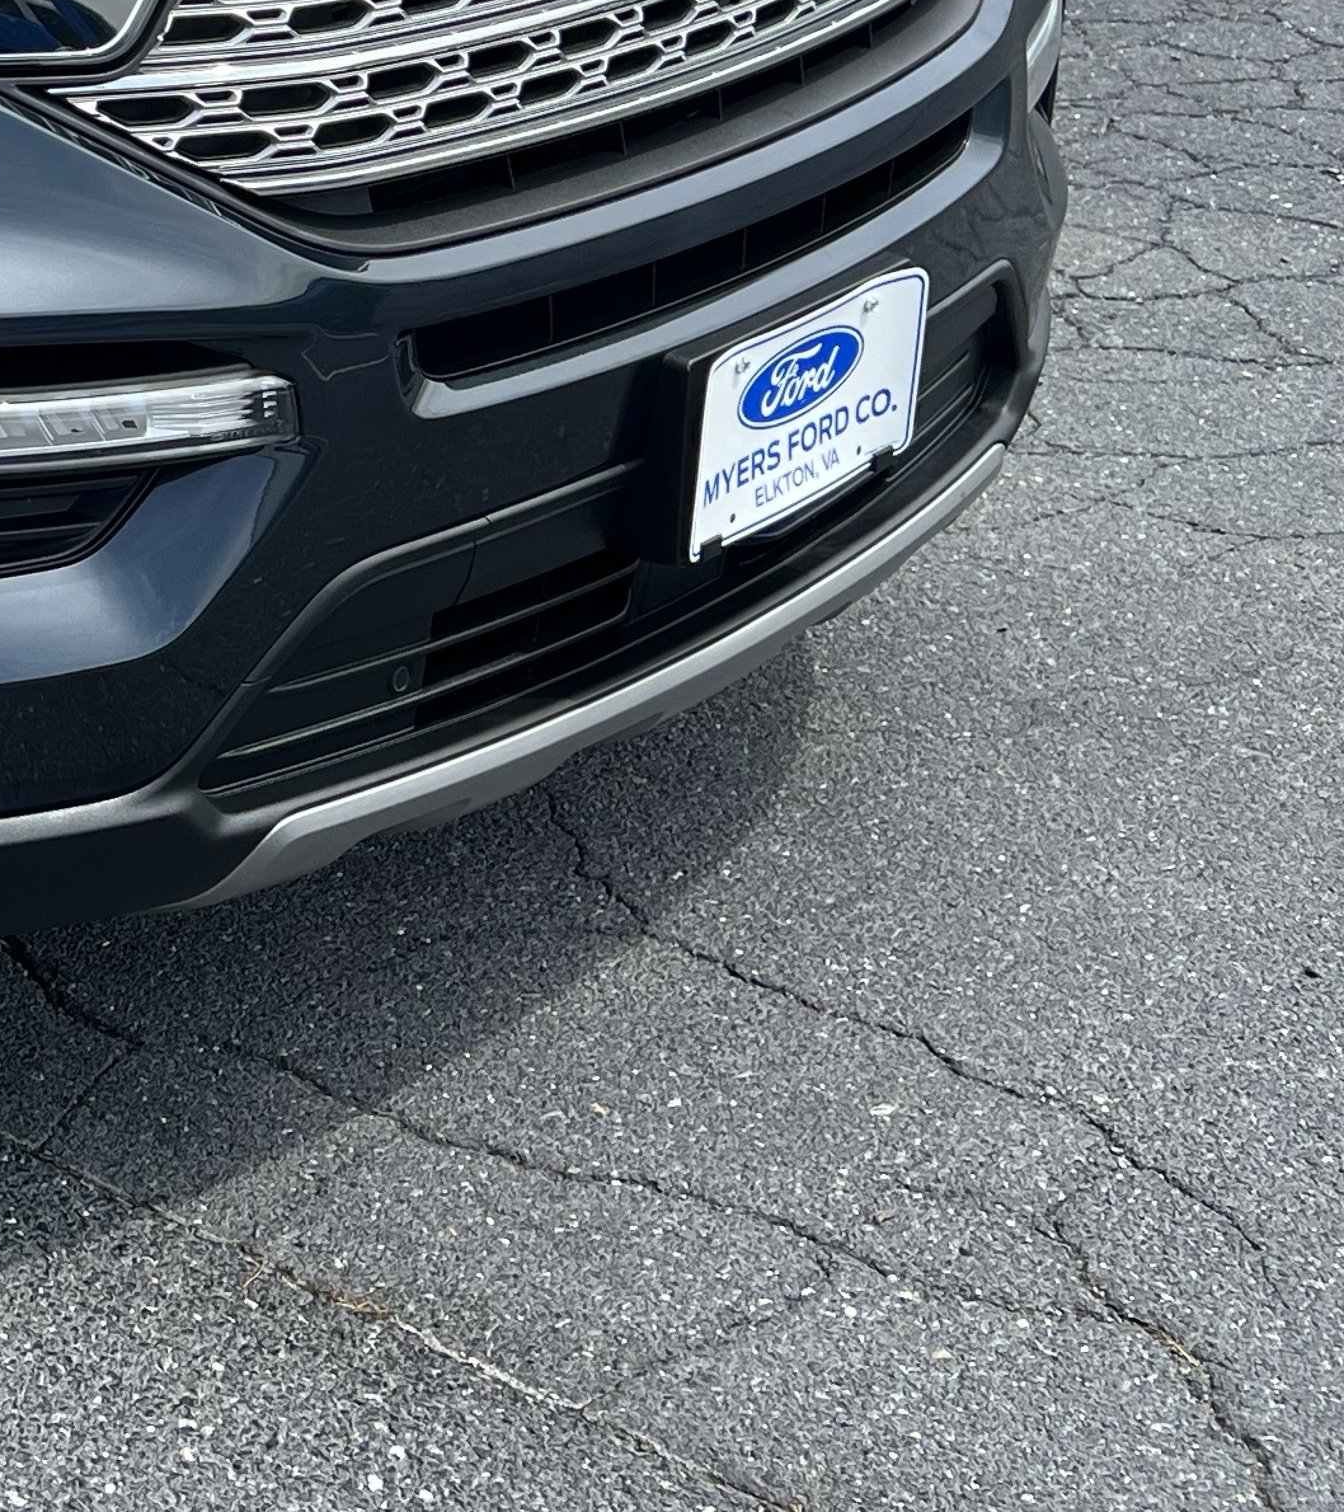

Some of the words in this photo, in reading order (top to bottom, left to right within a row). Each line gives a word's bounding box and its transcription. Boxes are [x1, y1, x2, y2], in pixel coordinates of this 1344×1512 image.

[760, 342, 841, 418] Ford
[703, 439, 781, 508] MYERS
[788, 405, 849, 460] FORD
[855, 388, 898, 424] CO.
[754, 462, 820, 508] ELKTON,
[822, 448, 840, 471] VA
